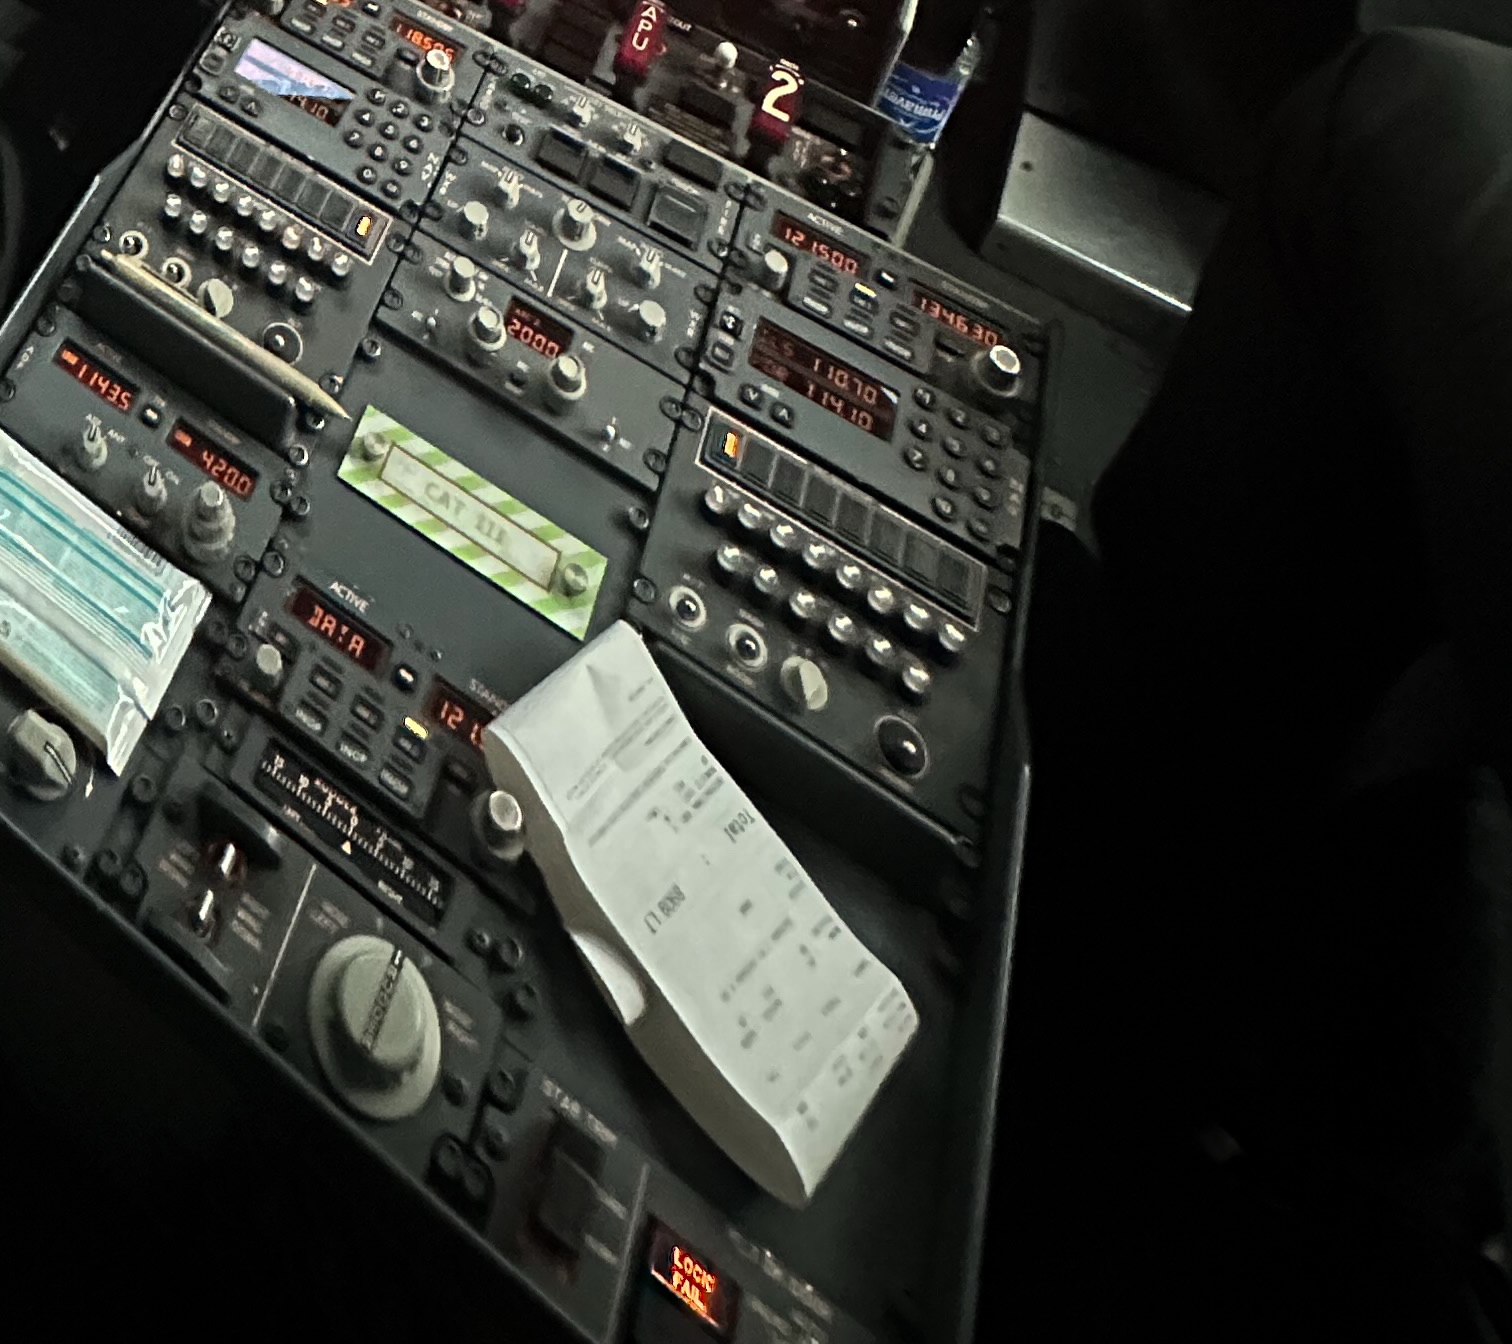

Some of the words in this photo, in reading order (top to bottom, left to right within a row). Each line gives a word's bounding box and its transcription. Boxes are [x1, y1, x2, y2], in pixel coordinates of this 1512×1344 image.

[631, 4, 659, 52] APU
[761, 69, 802, 123] 2
[506, 319, 561, 359] 2000
[423, 480, 464, 520] CAT
[329, 581, 371, 613] ACTIVE
[671, 1245, 716, 1294] LOCK
[671, 1270, 708, 1313] FAIL
